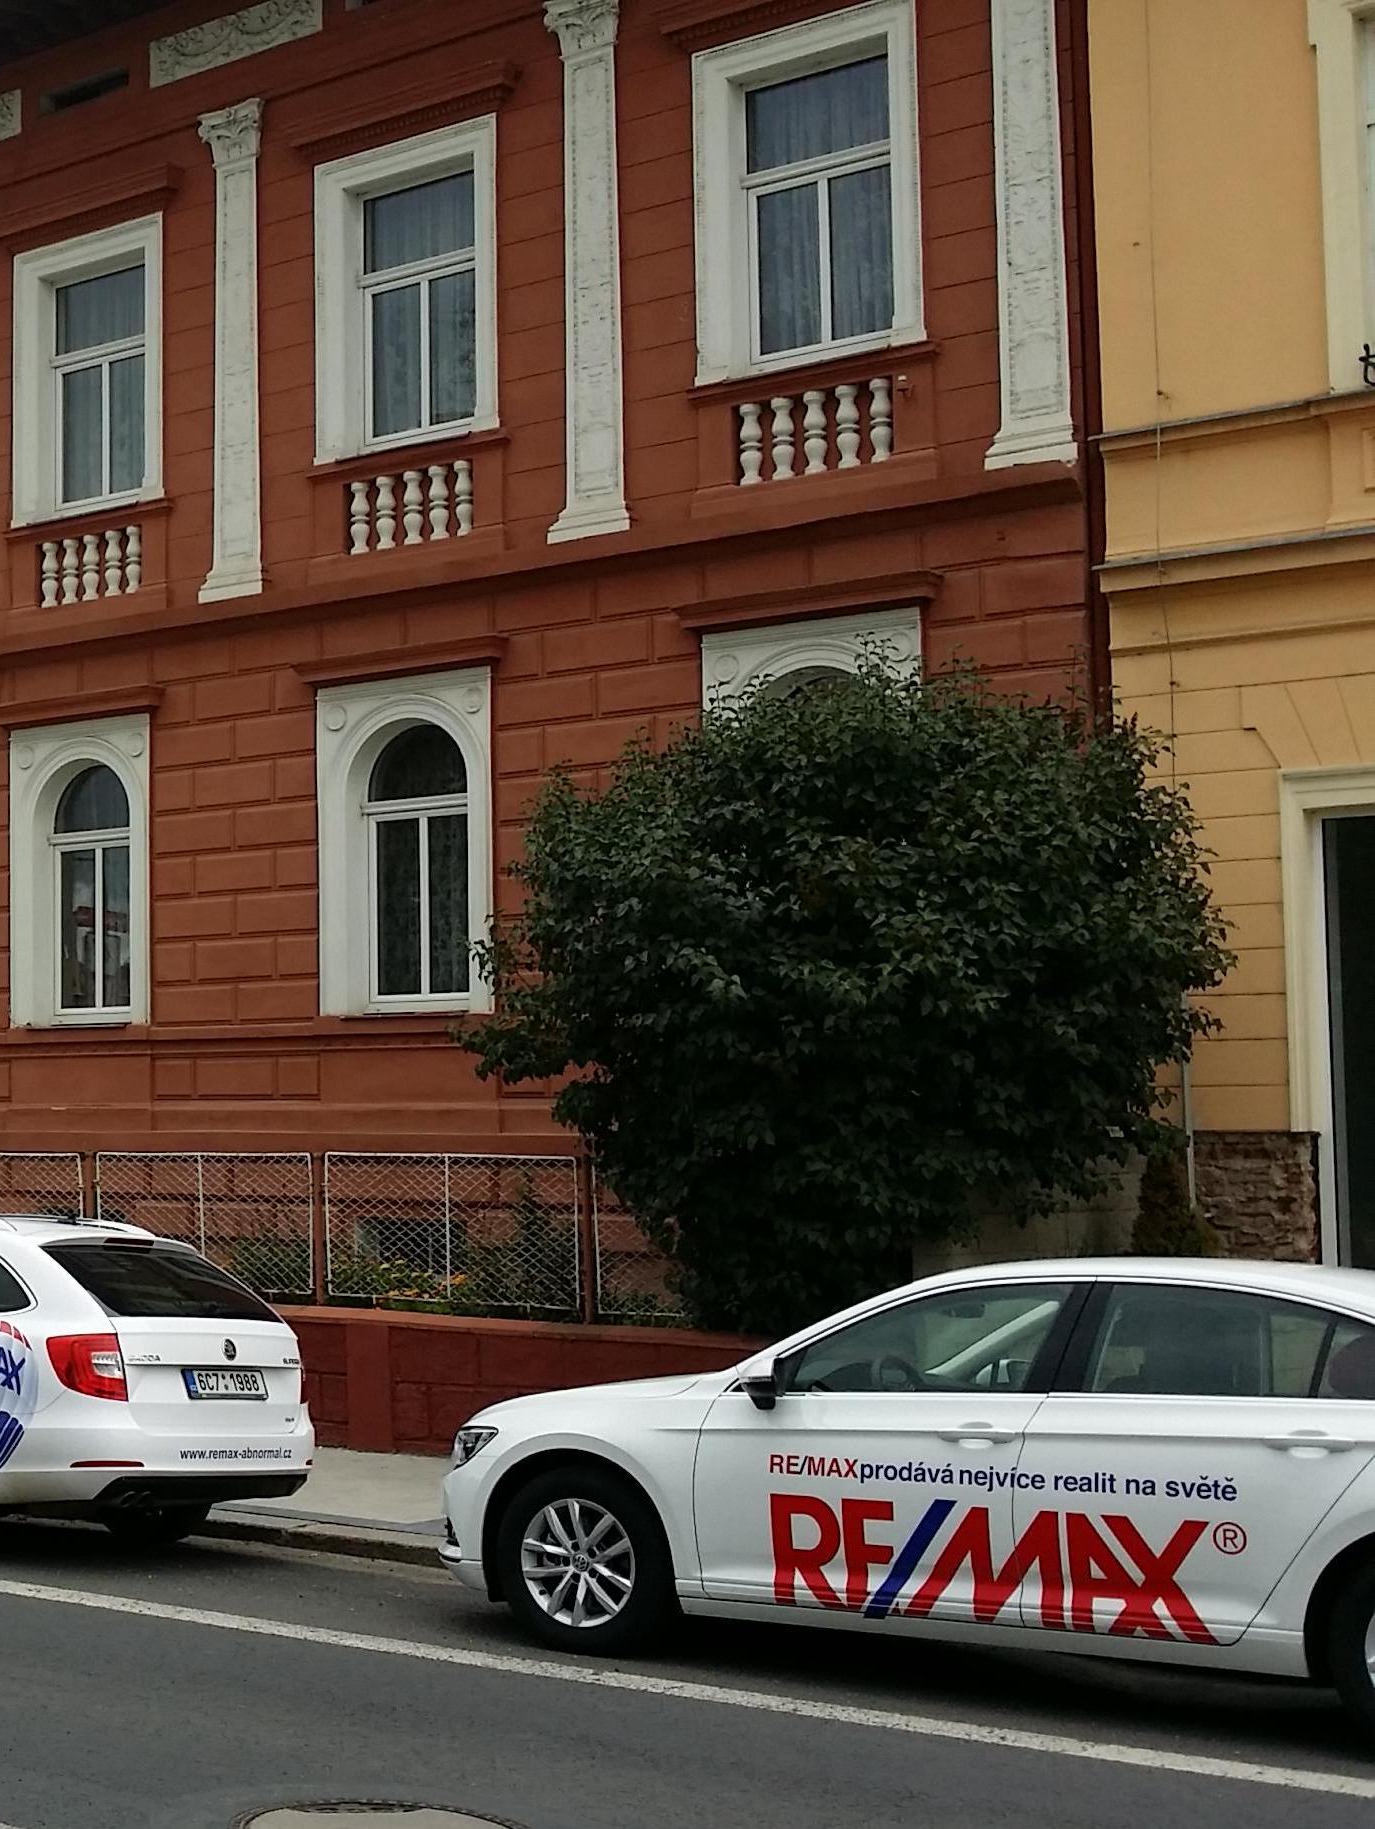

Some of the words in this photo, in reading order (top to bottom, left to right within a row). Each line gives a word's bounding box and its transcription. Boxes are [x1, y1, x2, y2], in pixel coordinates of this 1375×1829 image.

[197, 1373, 219, 1392] 6C7
[230, 1373, 260, 1392] 1988
[180, 1447, 292, 1460] www.remax-abnormal.cz
[769, 1454, 859, 1478] RE/MAX
[860, 1461, 954, 1483] prodává
[959, 1466, 1046, 1492] nejvíce
[1053, 1472, 1116, 1494] realit
[1126, 1478, 1156, 1496] na
[1165, 1475, 1238, 1501] světě
